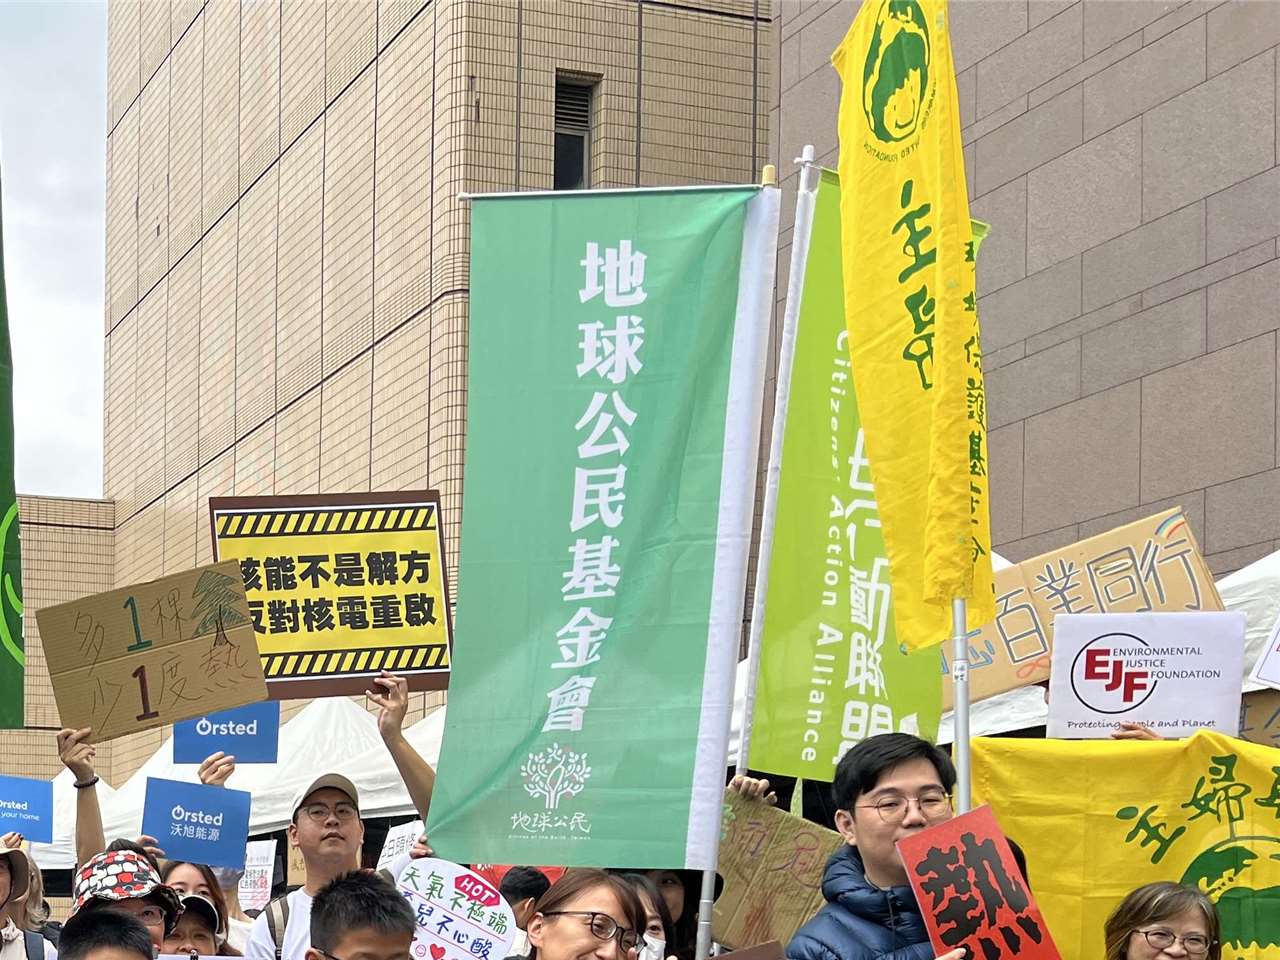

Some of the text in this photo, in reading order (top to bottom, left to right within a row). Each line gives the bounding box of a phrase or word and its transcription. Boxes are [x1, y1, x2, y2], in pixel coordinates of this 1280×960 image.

[541, 239, 648, 733] 地球公民基金會
[822, 494, 846, 607] Action
[239, 550, 432, 592] 核能不是解方
[251, 594, 438, 636] 反對核電重啟
[995, 539, 1203, 664] 百業同行
[1112, 647, 1203, 657] ENVIRONMENTAL
[1125, 659, 1166, 668] JUSTICE
[1084, 648, 1149, 702] EJF
[1150, 670, 1221, 680] FOUNDATION
[802, 623, 843, 762] Alliance
[1067, 719, 1120, 730] Protecting
[1158, 719, 1179, 728] and
[1182, 719, 1216, 728] Planet
[1, 811, 18, 819] your
[510, 811, 592, 833] 地球公民
[170, 822, 220, 842] 沃旭能源
[403, 866, 508, 935] 天氣不極端
[460, 878, 496, 903] HOT
